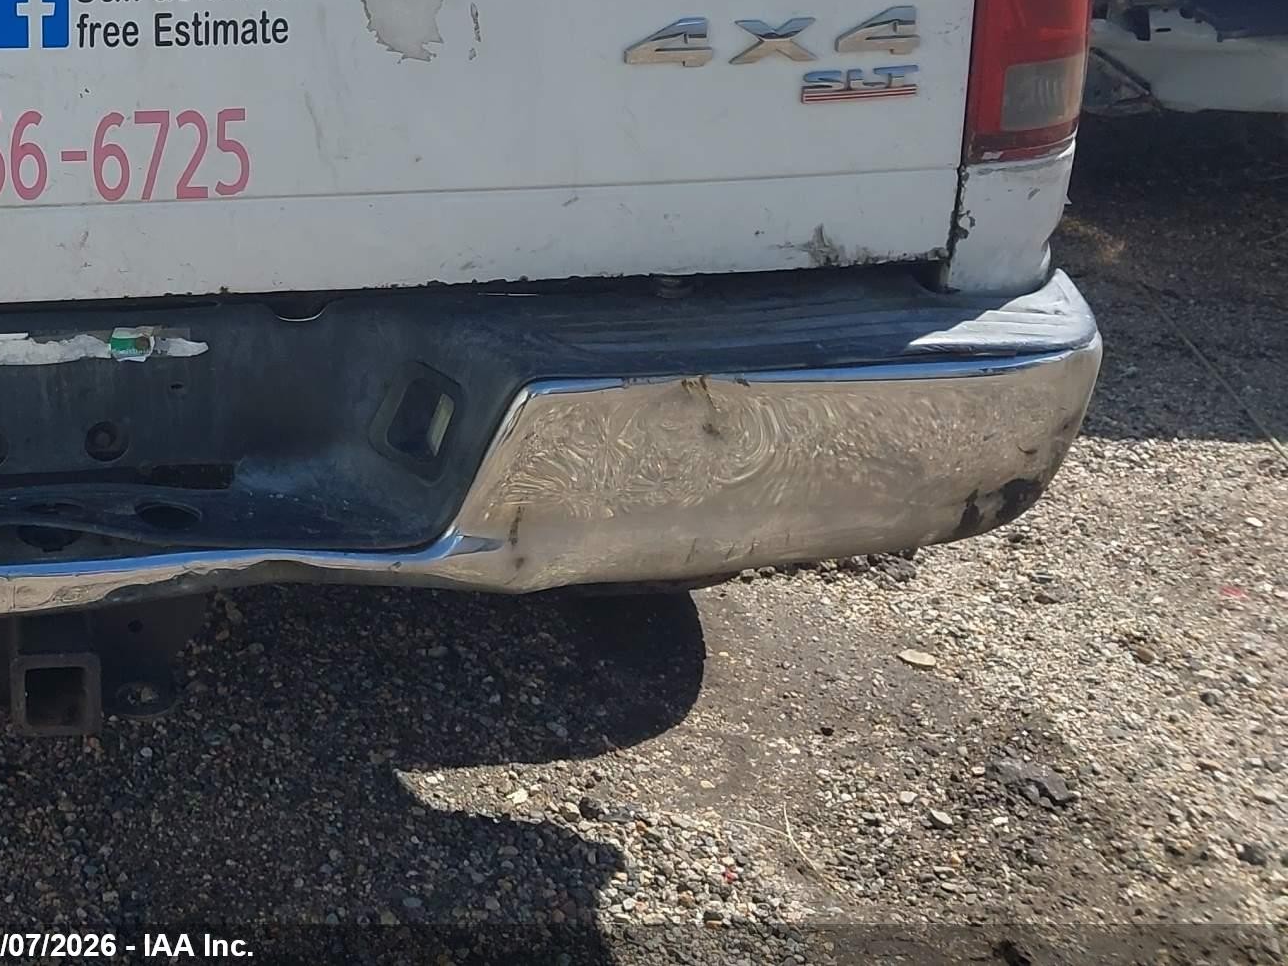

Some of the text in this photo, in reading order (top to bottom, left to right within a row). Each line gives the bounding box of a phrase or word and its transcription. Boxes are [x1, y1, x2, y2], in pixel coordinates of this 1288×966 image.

[76, 10, 289, 49] free Estimate
[801, 64, 919, 91] SLT
